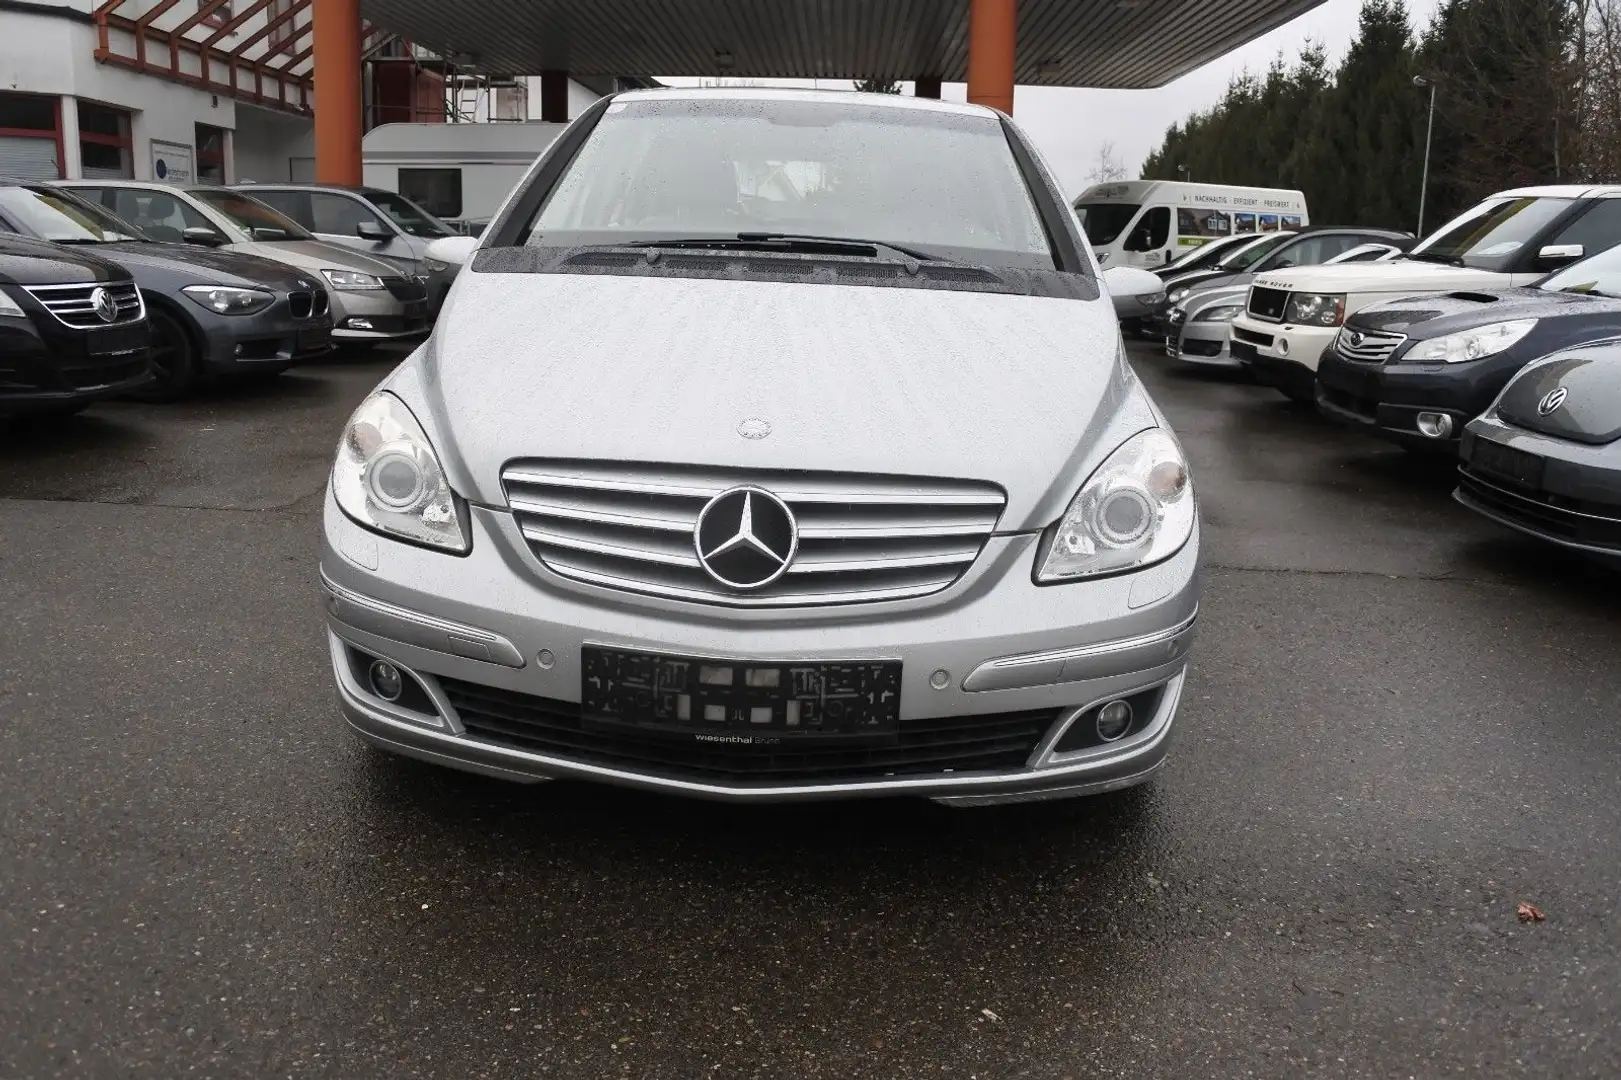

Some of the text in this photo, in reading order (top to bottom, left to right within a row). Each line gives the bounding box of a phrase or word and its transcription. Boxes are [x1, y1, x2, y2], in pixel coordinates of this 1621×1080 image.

[1194, 195, 1290, 209] NACHHALTIG EFFIZIENT PREISWERT
[695, 733, 752, 744] wiesenthal
